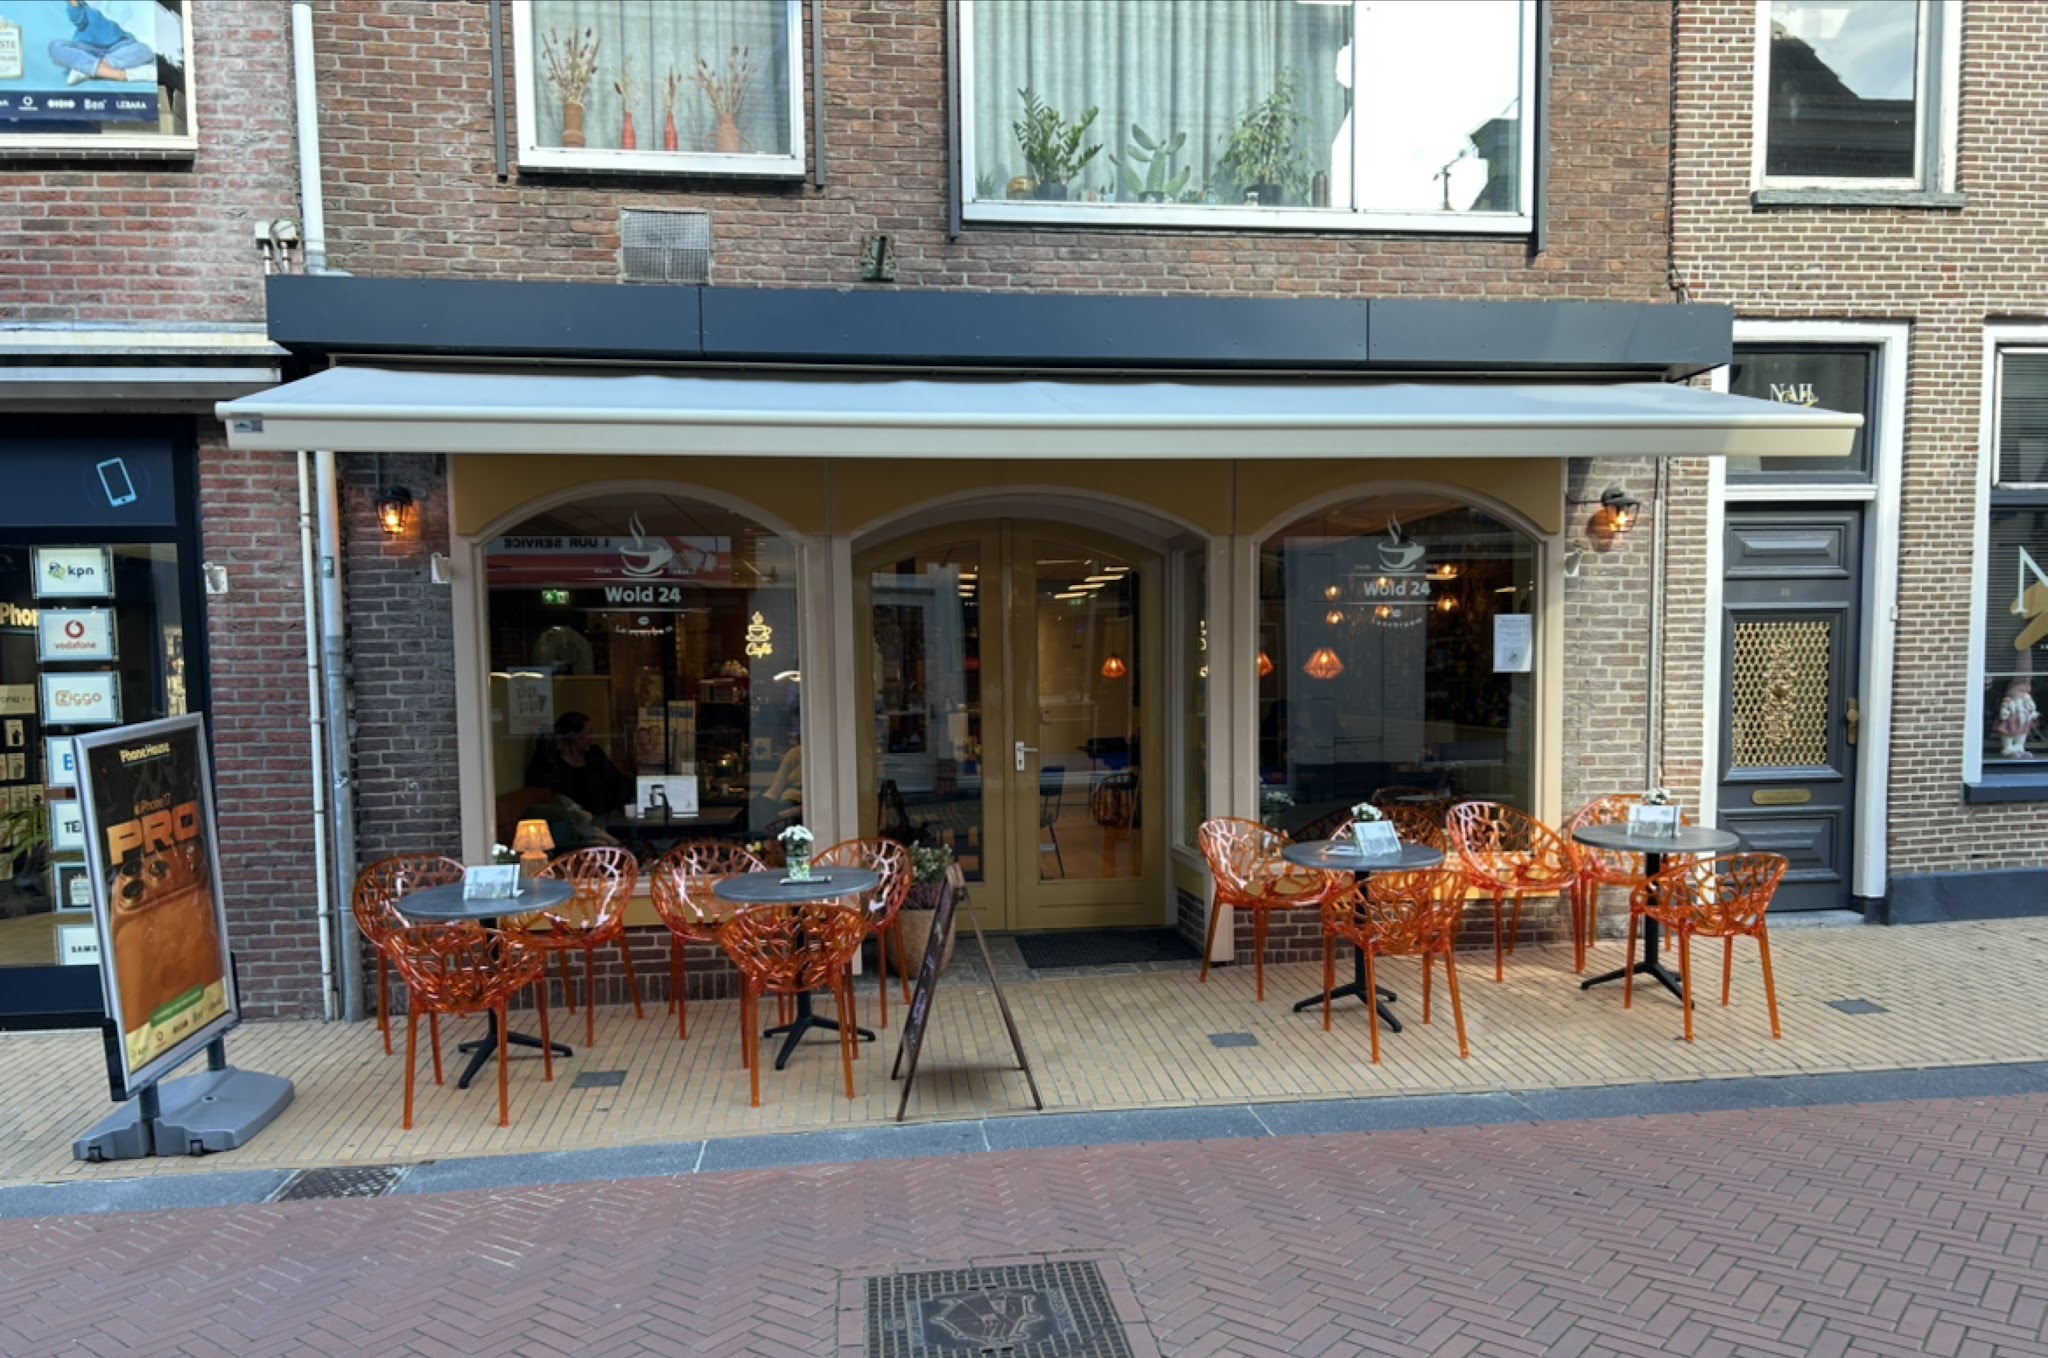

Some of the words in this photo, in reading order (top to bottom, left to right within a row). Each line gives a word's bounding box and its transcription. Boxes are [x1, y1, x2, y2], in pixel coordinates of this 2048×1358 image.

[67, 565, 95, 579] kpn
[604, 586, 654, 603] Wold
[658, 587, 682, 603] 24
[1363, 580, 1407, 596] Wold
[1410, 580, 1432, 596] 24
[54, 640, 97, 650] vodafone
[106, 801, 201, 866] PRO
